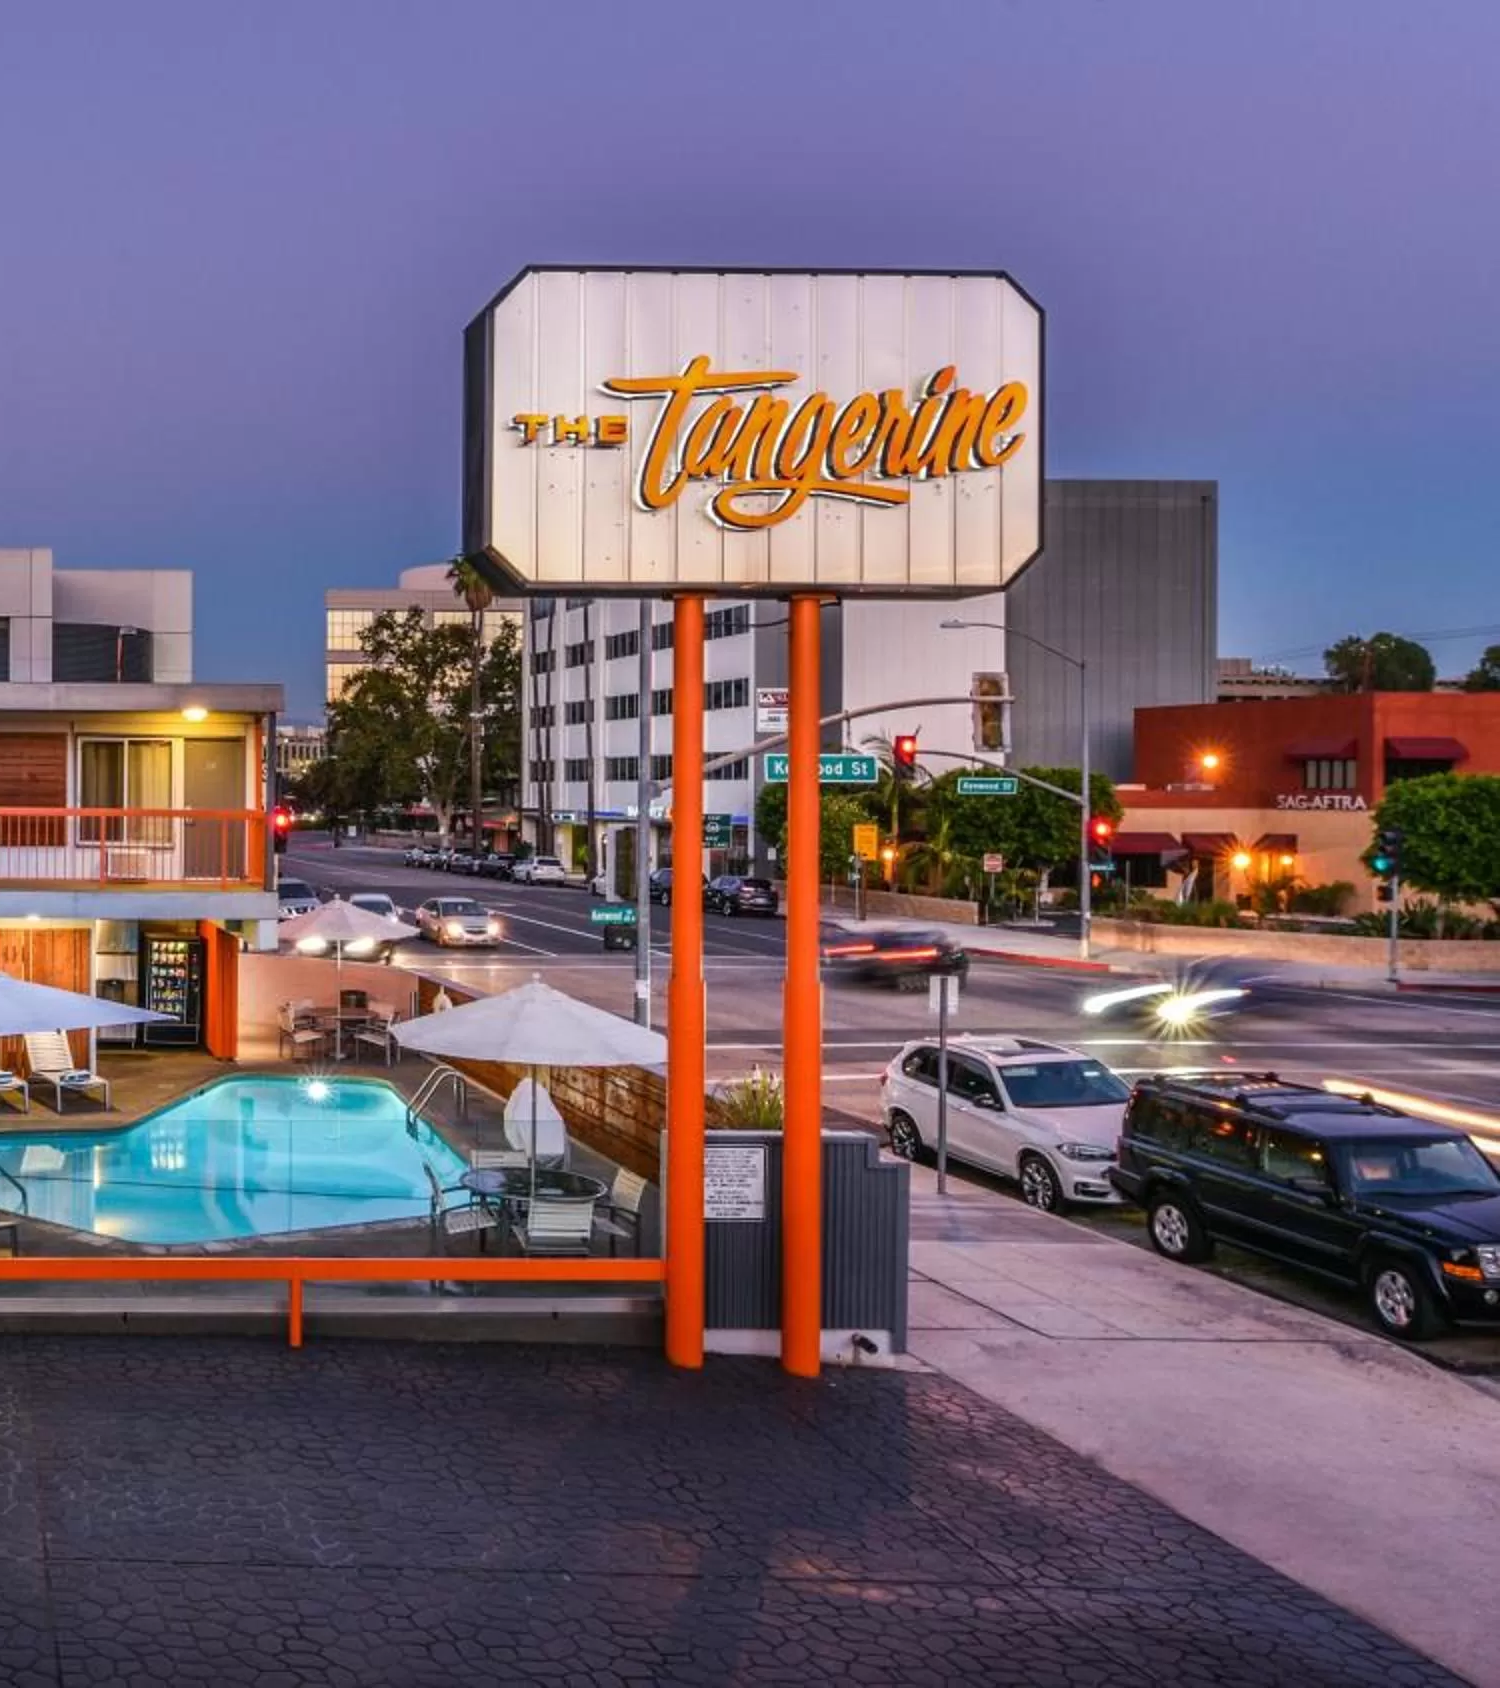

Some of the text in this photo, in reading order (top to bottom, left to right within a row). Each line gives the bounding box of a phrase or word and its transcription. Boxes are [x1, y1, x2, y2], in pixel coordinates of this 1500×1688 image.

[513, 413, 629, 447] THE
[851, 761, 869, 776] St
[1276, 794, 1368, 810] SAG-AFTRA
